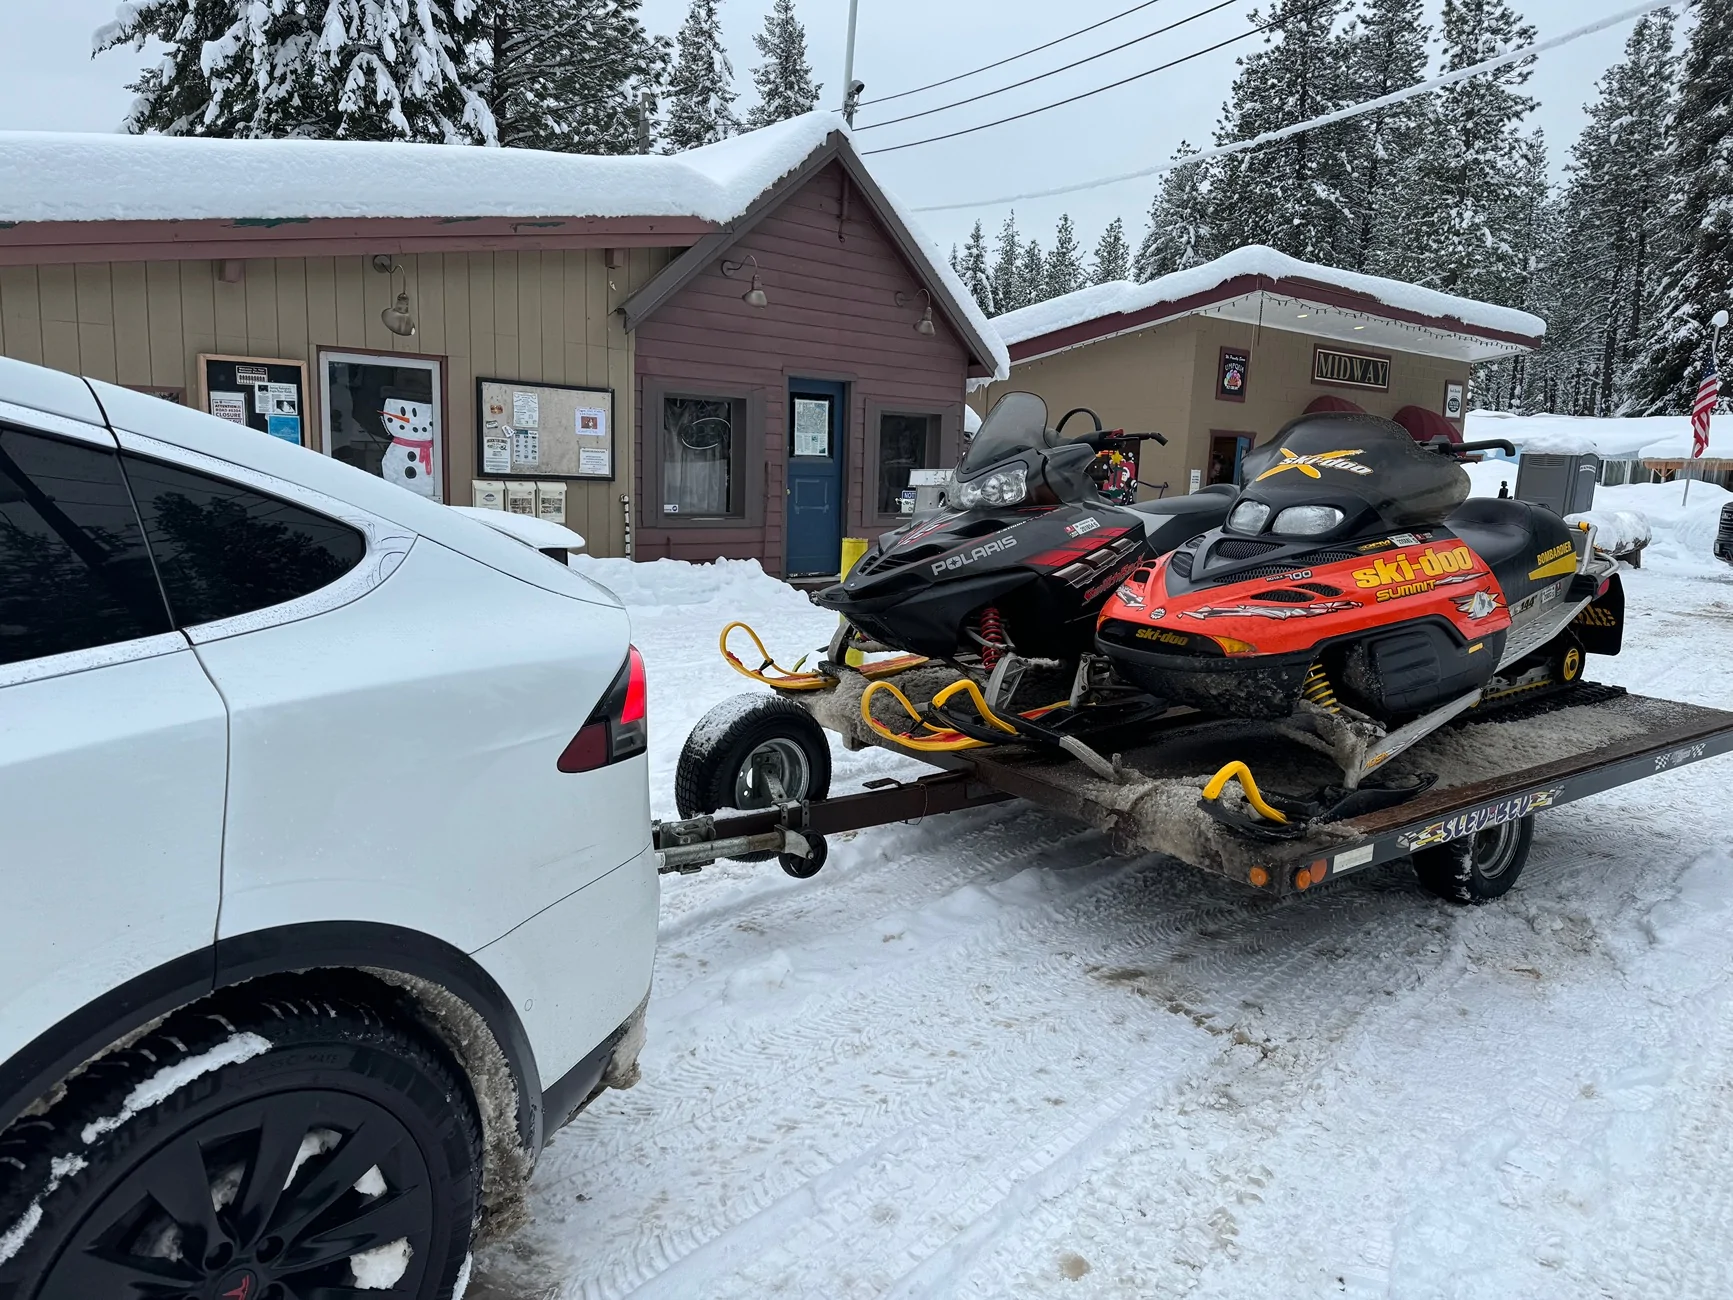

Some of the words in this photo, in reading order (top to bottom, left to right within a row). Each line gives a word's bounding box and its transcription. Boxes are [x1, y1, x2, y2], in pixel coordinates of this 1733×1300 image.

[1318, 353, 1387, 385] MIDWAY
[931, 535, 1018, 576] POLARIS
[1537, 541, 1572, 566] BOMBARDIER
[1285, 569, 1313, 581] 700
[1352, 546, 1475, 589] ski-doo
[1375, 579, 1437, 603] SUMMIT
[1135, 628, 1189, 646] ski-doo
